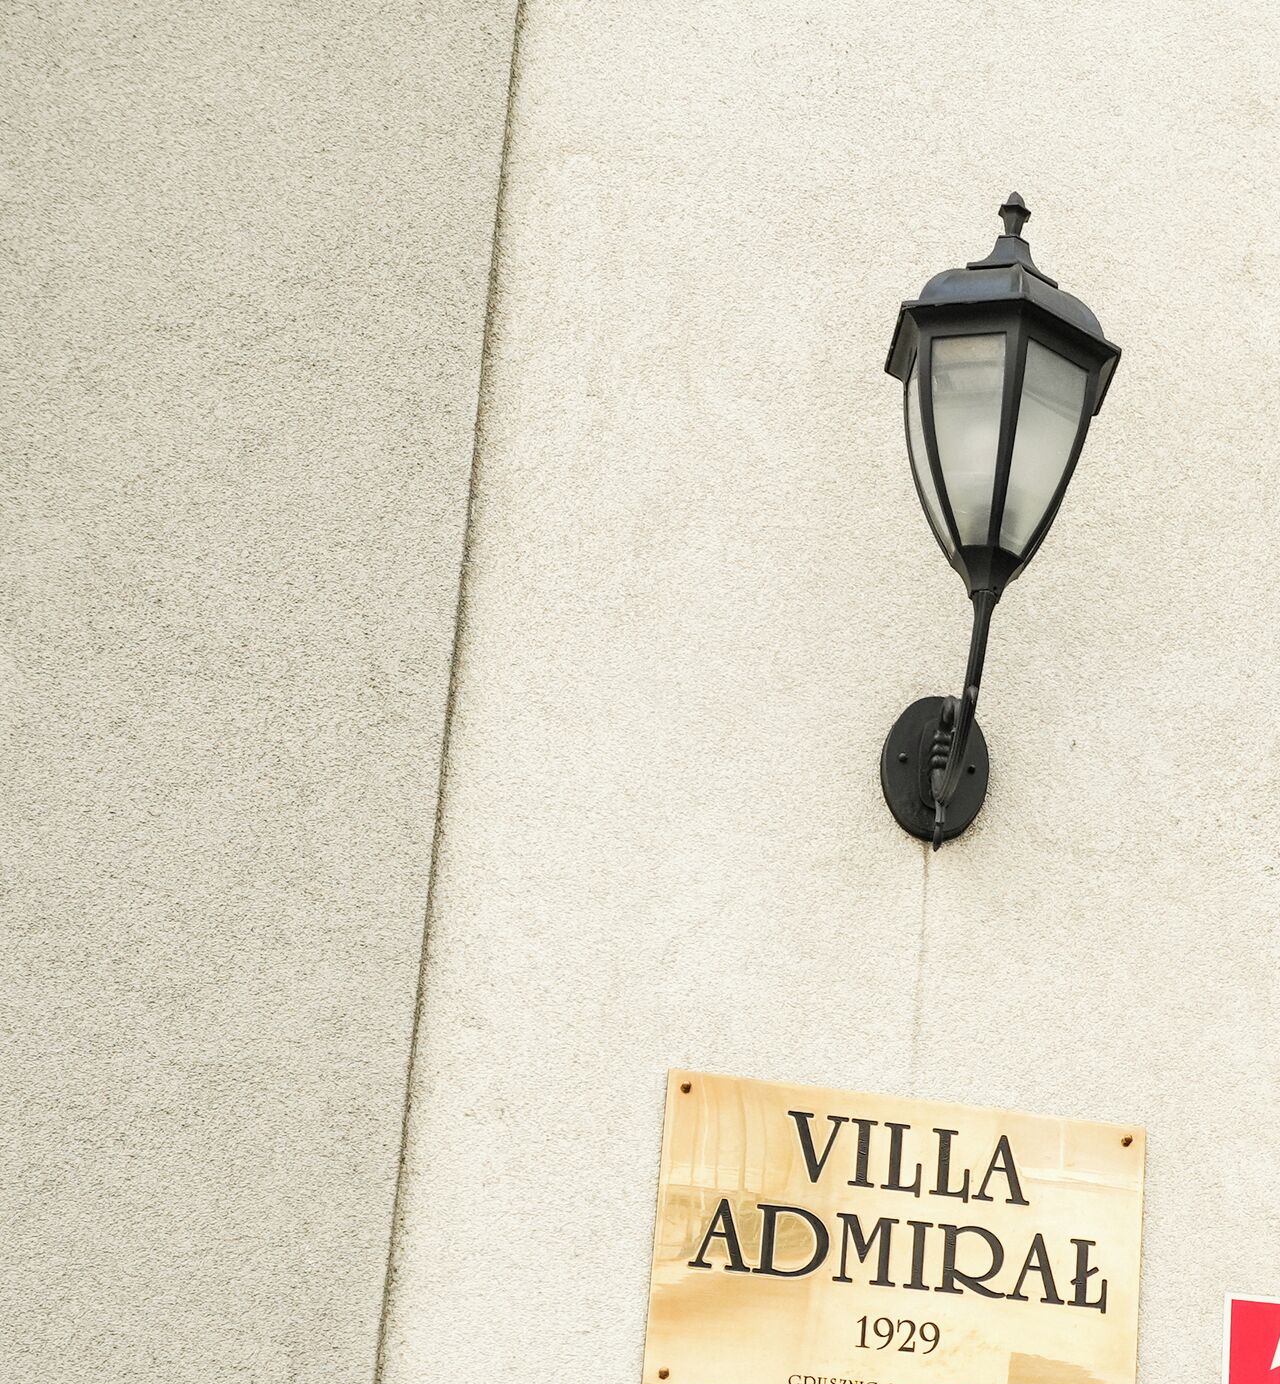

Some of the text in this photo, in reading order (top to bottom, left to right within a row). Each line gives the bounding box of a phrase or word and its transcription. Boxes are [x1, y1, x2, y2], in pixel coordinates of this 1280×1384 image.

[788, 1110, 1030, 1206] VILLA
[688, 1198, 1108, 1314] ADMIRAŁ
[855, 1315, 941, 1355] 1929
